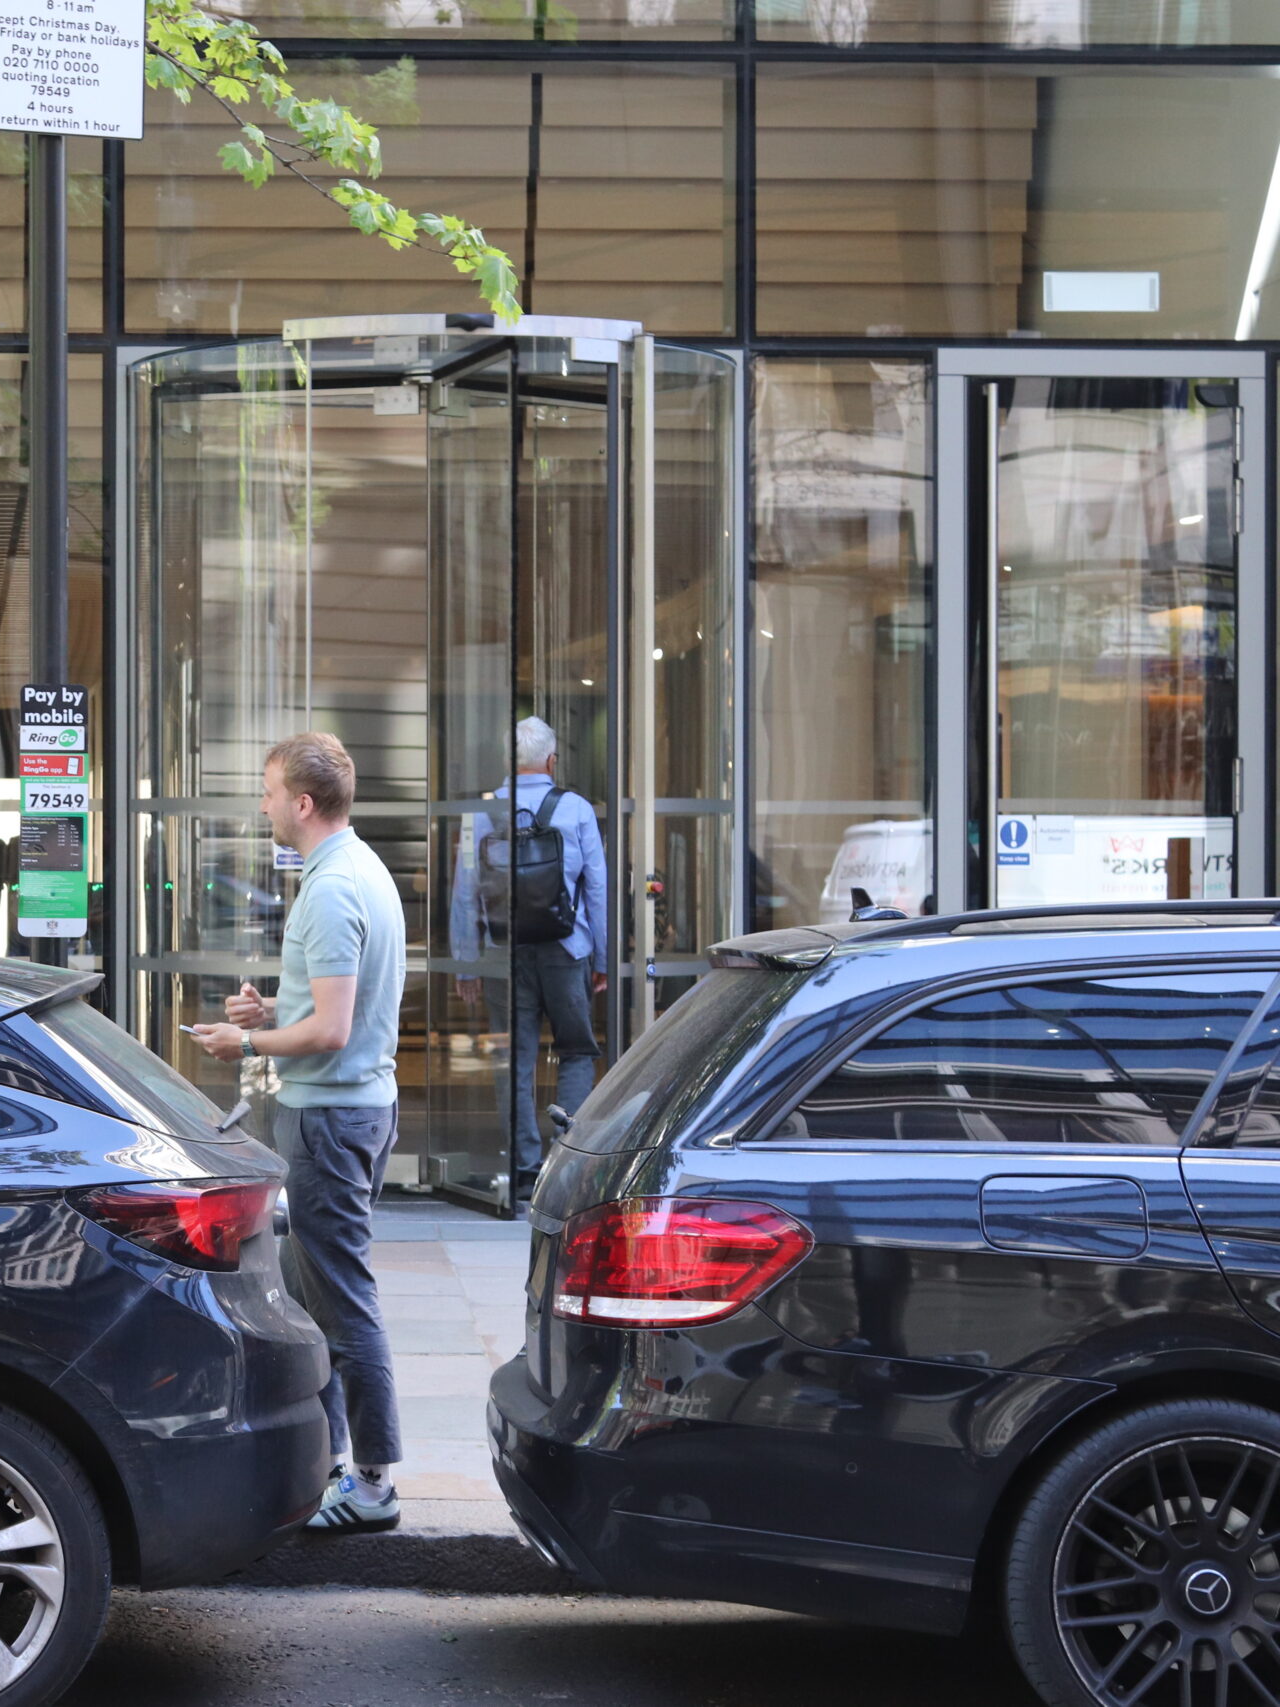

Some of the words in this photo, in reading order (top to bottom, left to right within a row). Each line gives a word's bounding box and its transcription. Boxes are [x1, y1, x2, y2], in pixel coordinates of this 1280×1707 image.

[29, 16, 90, 31] Christmas
[0, 26, 37, 42] Friday
[41, 32, 53, 41] or
[57, 31, 86, 44] bank
[90, 34, 139, 50] holidays
[12, 44, 33, 57] Pay
[37, 46, 51, 58] by
[55, 48, 91, 60] phone
[3, 56, 28, 68] 020
[33, 58, 59, 71] 7110
[63, 61, 99, 74] 0000
[2, 71, 48, 85] quoting
[51, 73, 100, 87] location
[31, 84, 70, 98] 79549
[26, 101, 35, 111] 4
[39, 102, 74, 114] hours
[1, 115, 39, 127] return
[43, 117, 80, 129] within
[84, 120, 89, 130] 1
[93, 121, 121, 132] hour
[24, 687, 57, 706] Pay
[62, 687, 84, 706] by
[25, 708, 84, 724] mobile
[23, 766, 49, 774] RingGo
[29, 793, 84, 808] 79549
